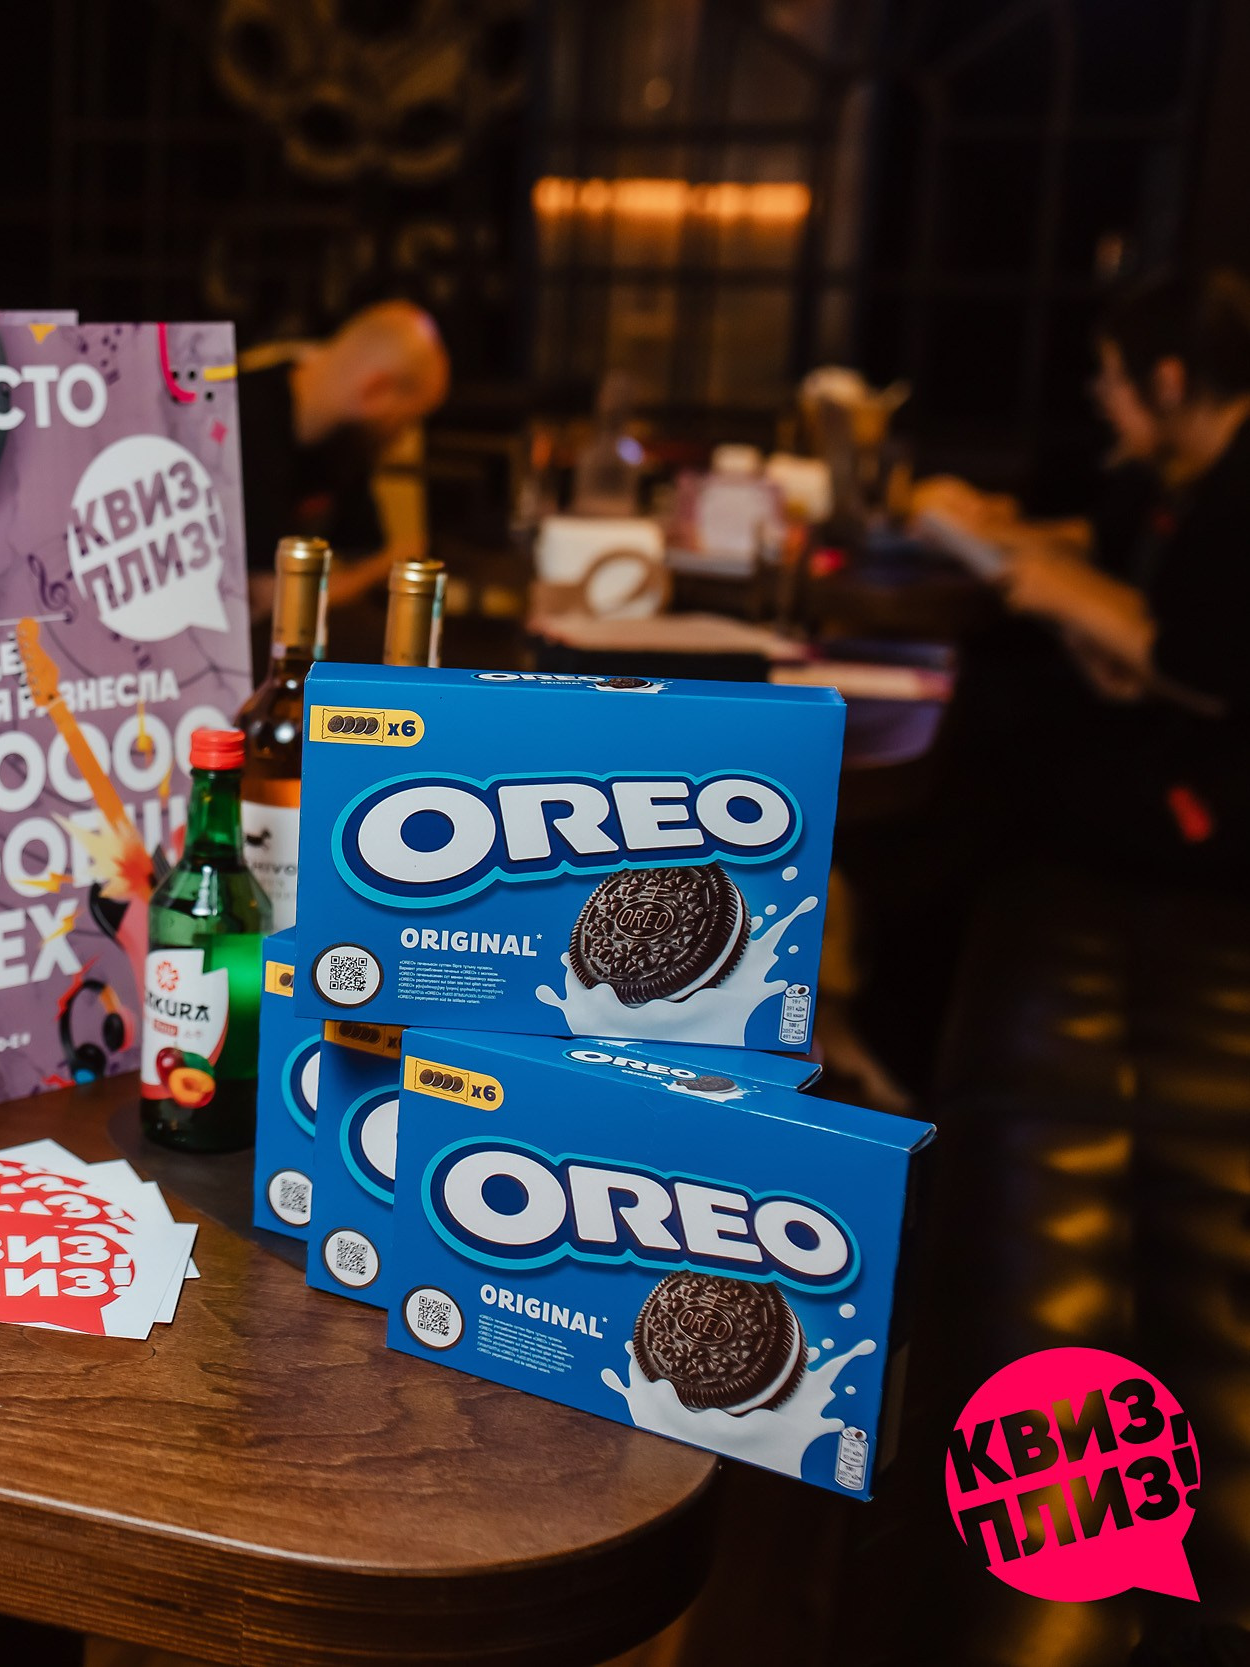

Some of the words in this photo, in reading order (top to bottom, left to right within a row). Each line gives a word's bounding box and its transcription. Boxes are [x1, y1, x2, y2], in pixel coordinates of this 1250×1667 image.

[72, 461, 216, 557] КВИЗ,
[81, 514, 225, 610] ПЛИЗ!
[18, 668, 180, 720] РЗНЕСЛА
[478, 673, 606, 682] OREO
[386, 719, 417, 738] x6
[357, 779, 790, 882] OREO
[618, 906, 674, 936] OREO
[570, 1050, 697, 1079] OREO
[469, 1083, 497, 1102] x6
[444, 1151, 849, 1276] OREO
[678, 1307, 731, 1342] OREO
